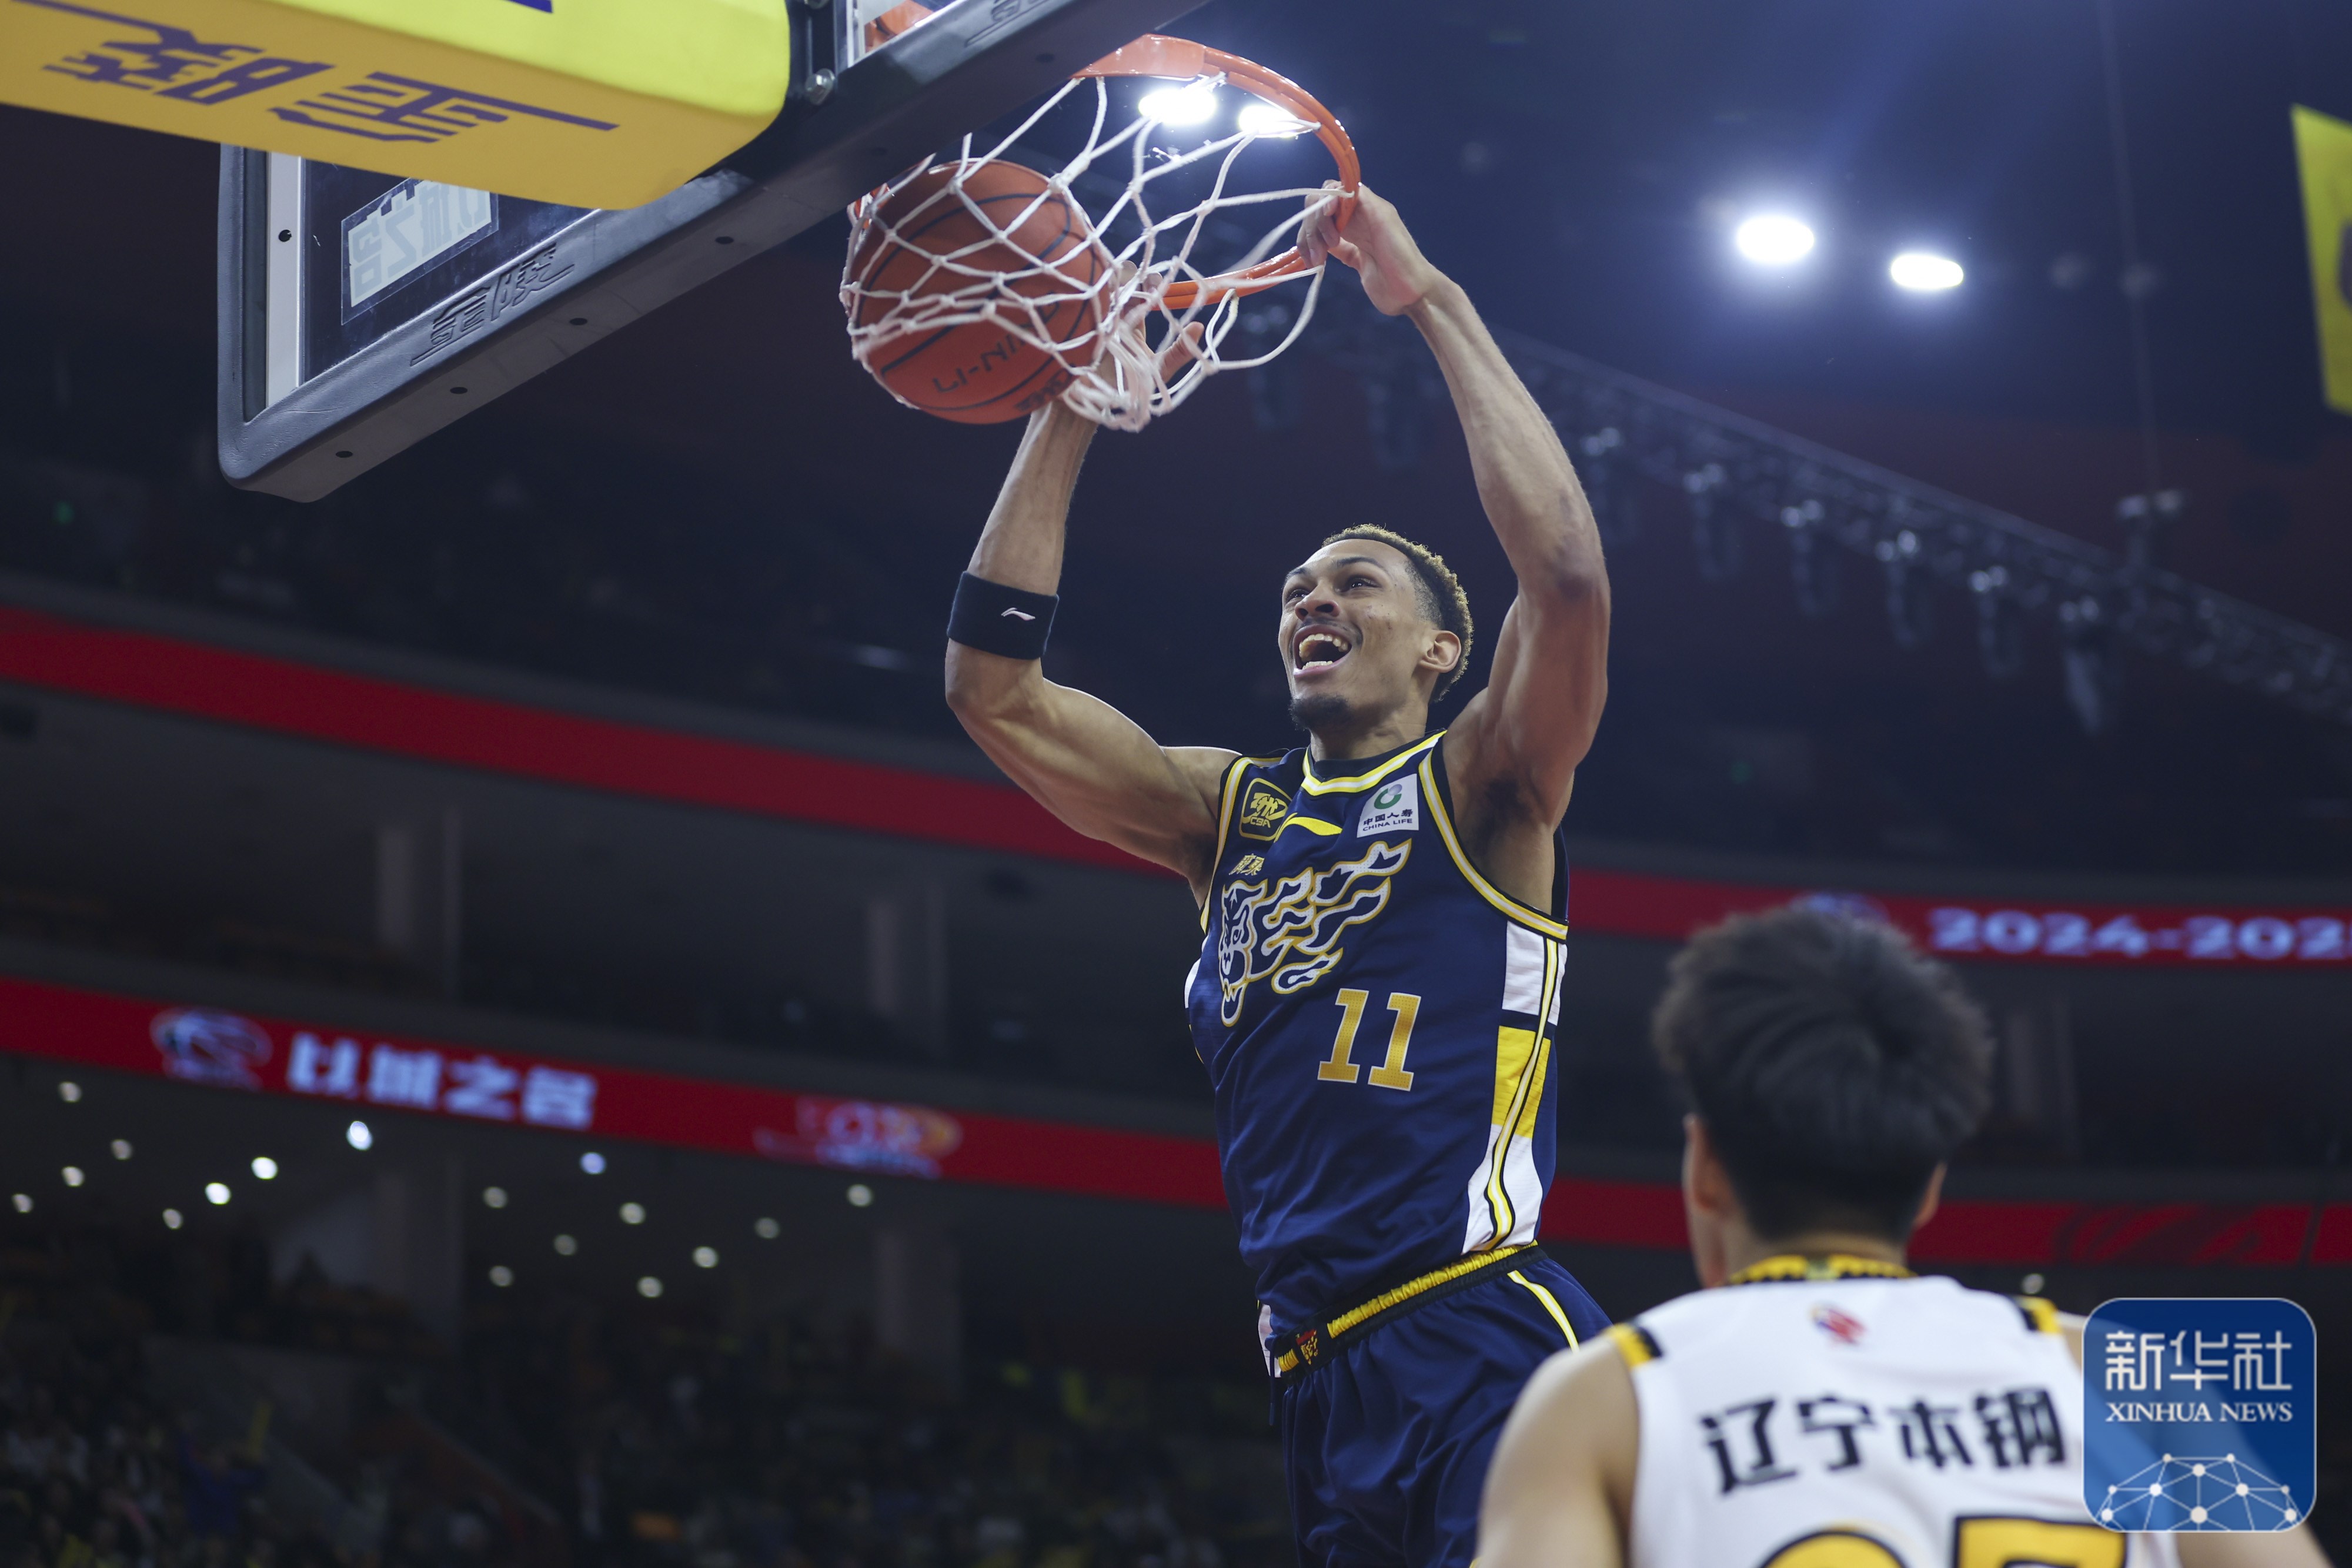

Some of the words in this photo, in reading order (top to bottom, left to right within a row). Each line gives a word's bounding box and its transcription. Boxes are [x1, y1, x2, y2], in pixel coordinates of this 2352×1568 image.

[1362, 822, 1390, 831] CHINA
[1363, 809, 1413, 825] 中国人寿
[1927, 907, 2352, 959] 2024-202
[1317, 988, 1421, 1092] 11
[1699, 1386, 2069, 1496] 辽宁本钢
